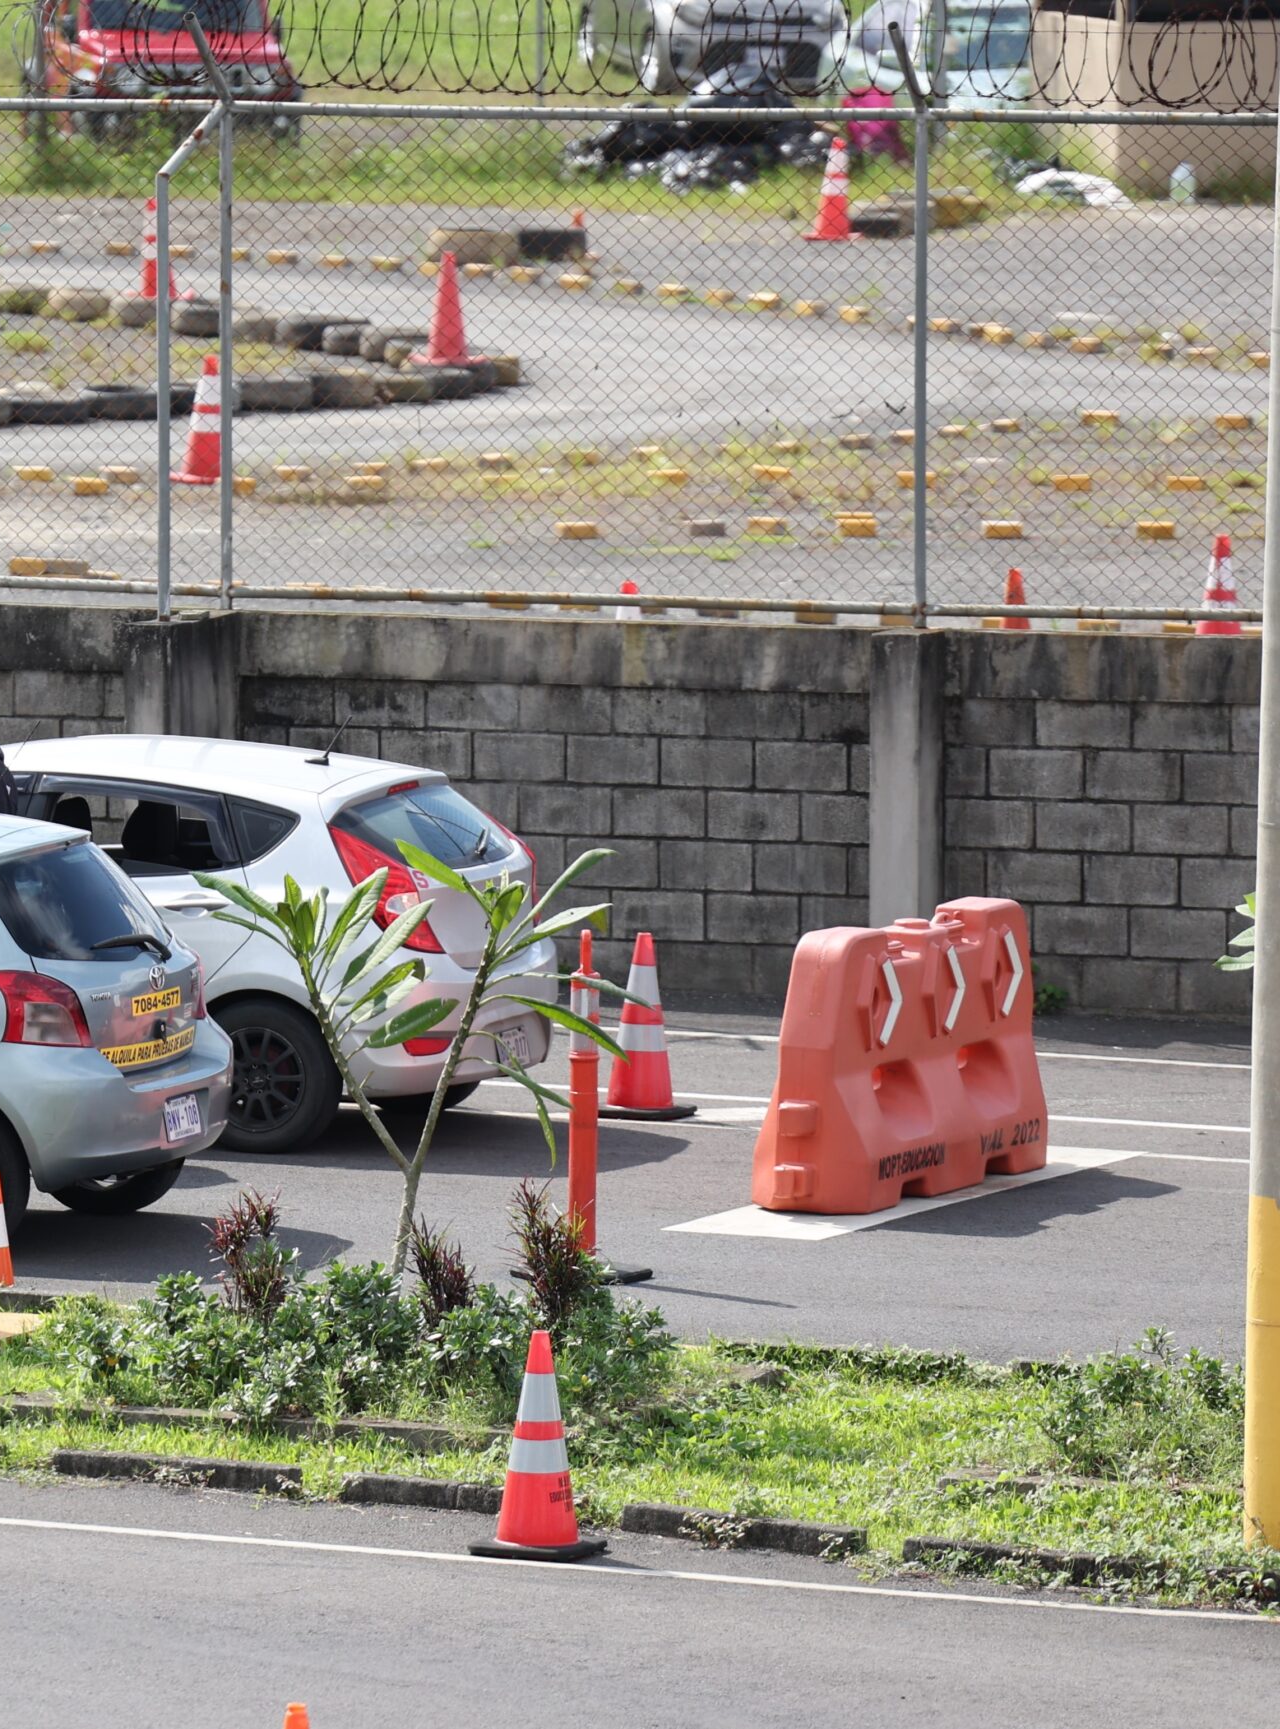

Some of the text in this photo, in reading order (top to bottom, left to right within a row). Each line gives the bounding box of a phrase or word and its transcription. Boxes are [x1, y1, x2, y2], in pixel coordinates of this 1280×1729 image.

[134, 989, 179, 1014] 7084-4577
[111, 1048, 136, 1064] ALQUILA
[137, 1045, 151, 1060] PARA
[1011, 1118, 1040, 1146] 2022
